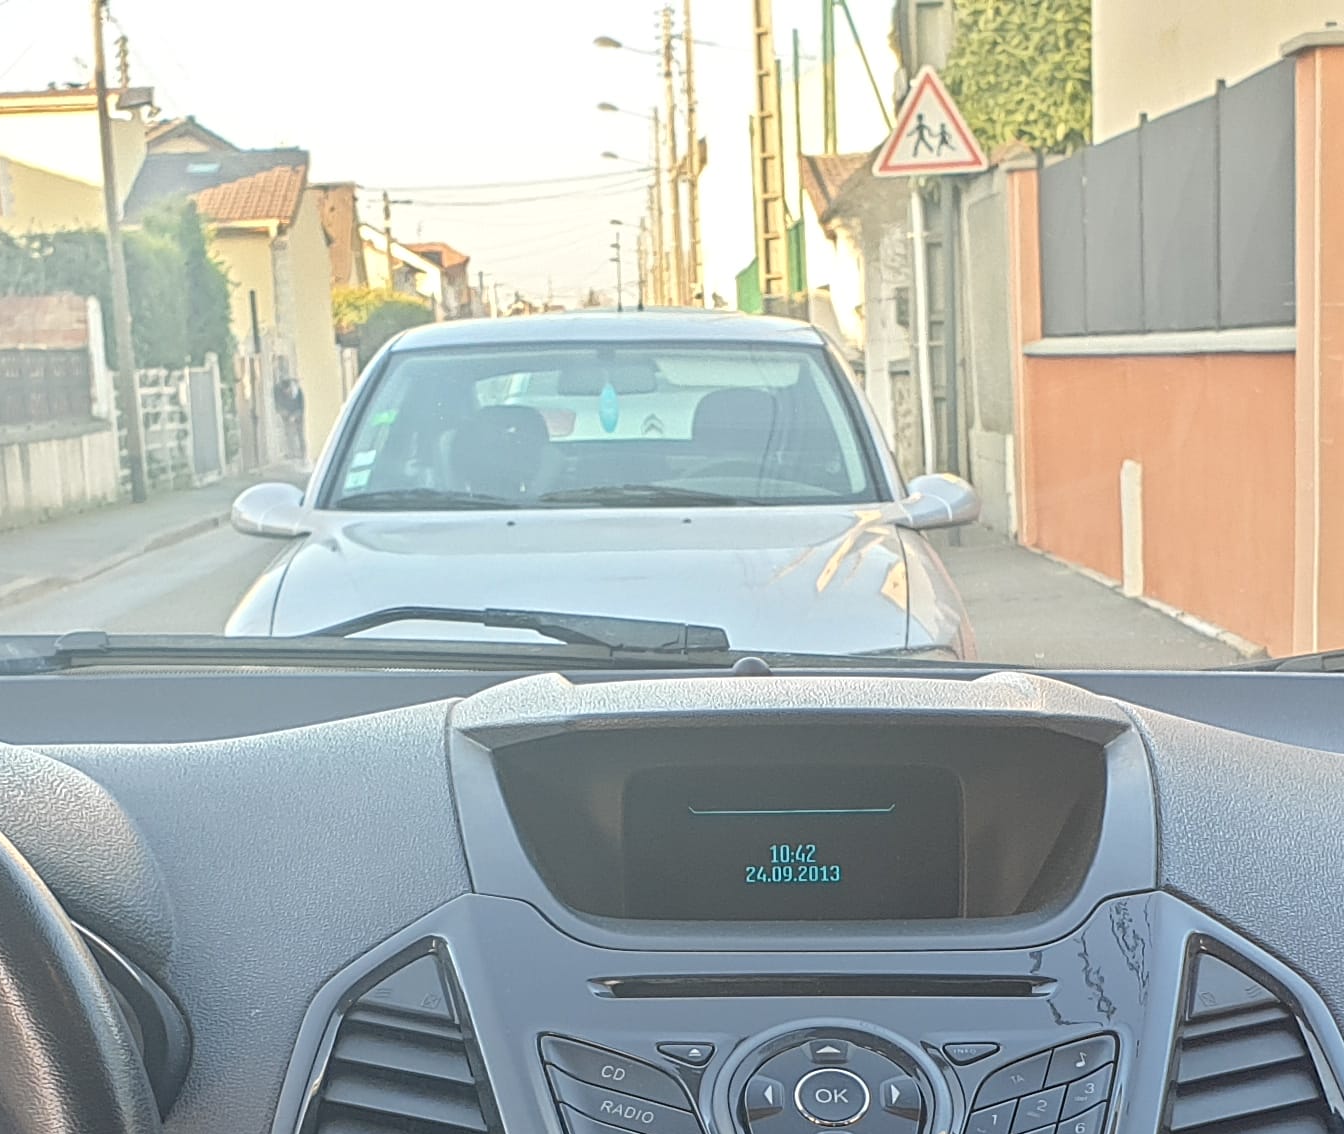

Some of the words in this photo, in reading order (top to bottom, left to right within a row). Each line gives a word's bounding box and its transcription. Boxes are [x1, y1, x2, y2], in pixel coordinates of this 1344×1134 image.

[769, 844, 816, 863] 10:42
[745, 865, 841, 883] 24.09.2013
[601, 1065, 626, 1081] CD
[815, 1087, 849, 1104] OK
[1084, 1082, 1095, 1094] 3
[600, 1100, 655, 1124] RADIO
[1037, 1100, 1048, 1112] 2
[991, 1114, 999, 1125] 1
[1075, 1122, 1086, 1134] 6
